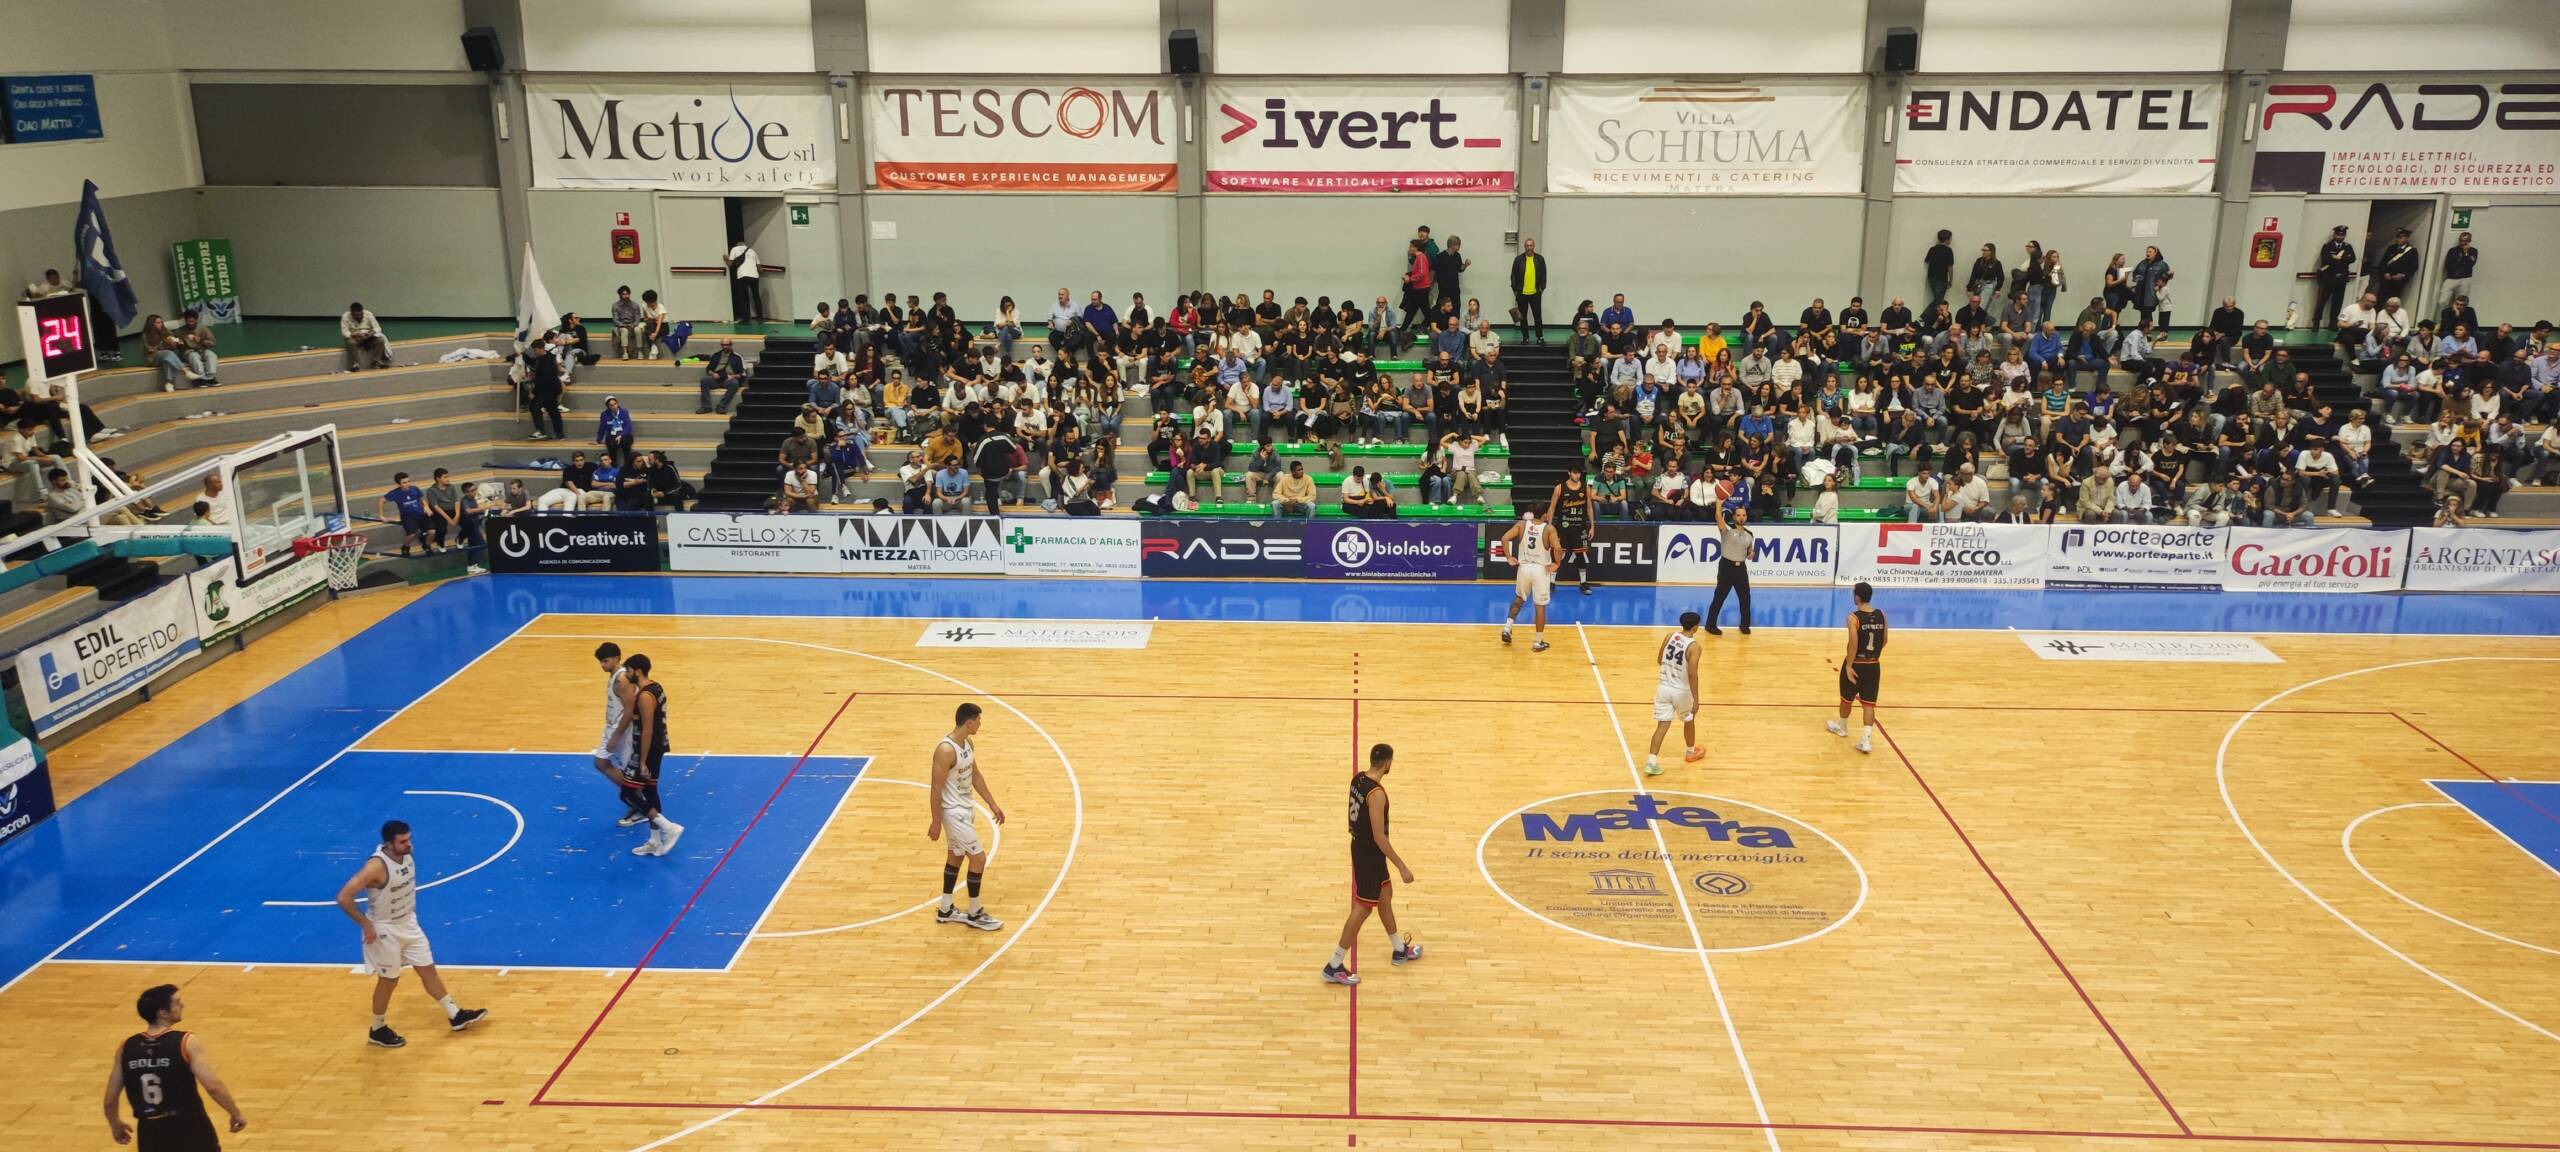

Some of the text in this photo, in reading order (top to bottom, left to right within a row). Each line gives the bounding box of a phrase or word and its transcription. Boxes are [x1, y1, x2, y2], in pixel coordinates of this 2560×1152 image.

[1906, 89, 2209, 131] ONDATEL
[2264, 82, 2560, 131] RADE
[16, 117, 74, 132] CIAO MATTIA
[552, 81, 816, 162] Metide srl
[884, 87, 1165, 145] TESCOM
[1594, 119, 1813, 164] SCHIUMA
[2331, 151, 2478, 162] IMPIANTI ELETTRICI,
[672, 166, 817, 184] work safety
[889, 171, 1166, 183] CUSTOMER EXPERIENCE MANAGEMENT
[1593, 172, 1815, 183] RICEVIMENTI & CATERING
[2330, 164, 2555, 174] TECNOLOGICI, DI SICUREZZA ED
[1220, 177, 1501, 187] SOFTWARE VERTICALI E BLOCKCHAIN
[2328, 176, 2554, 186] EFFICIENTAMENTO ENERGETICO
[176, 245, 191, 300] SETTORE
[199, 241, 217, 296] SETTORE
[215, 255, 231, 295] VERDE
[187, 257, 200, 298] VERDE
[43, 315, 82, 357] 24
[688, 527, 821, 543] CASELLO 75
[1932, 525, 1985, 537] EDILIZIA
[2093, 529, 2215, 549] porteaparte
[1034, 536, 1139, 546] FARMACIA D'ARIA Srl
[1142, 537, 1302, 560] RADE
[1375, 540, 1451, 556] biolabor
[1527, 536, 1536, 549] 3
[1930, 537, 1988, 549] FRATELLI
[1929, 550, 2000, 566] SACCO
[2092, 550, 2214, 561] www.porteaparte.it
[2232, 544, 2393, 578] Garofoli
[1775, 569, 1794, 577] OUR
[2413, 563, 2480, 573] ORGANISMO
[2484, 565, 2496, 573] DI
[2272, 580, 2302, 589] energia
[2304, 580, 2312, 588] al
[2328, 580, 2359, 589] servizio
[74, 624, 124, 661] EDIL
[1866, 631, 1875, 651] 1
[83, 623, 178, 686] LOPERFIDO
[1666, 644, 1684, 666] 34
[1521, 793, 1797, 849] Matera
[1526, 848, 1807, 865] Il senso della meraviglia
[1591, 875, 1657, 890] UNESCO
[140, 1073, 163, 1105] 6
